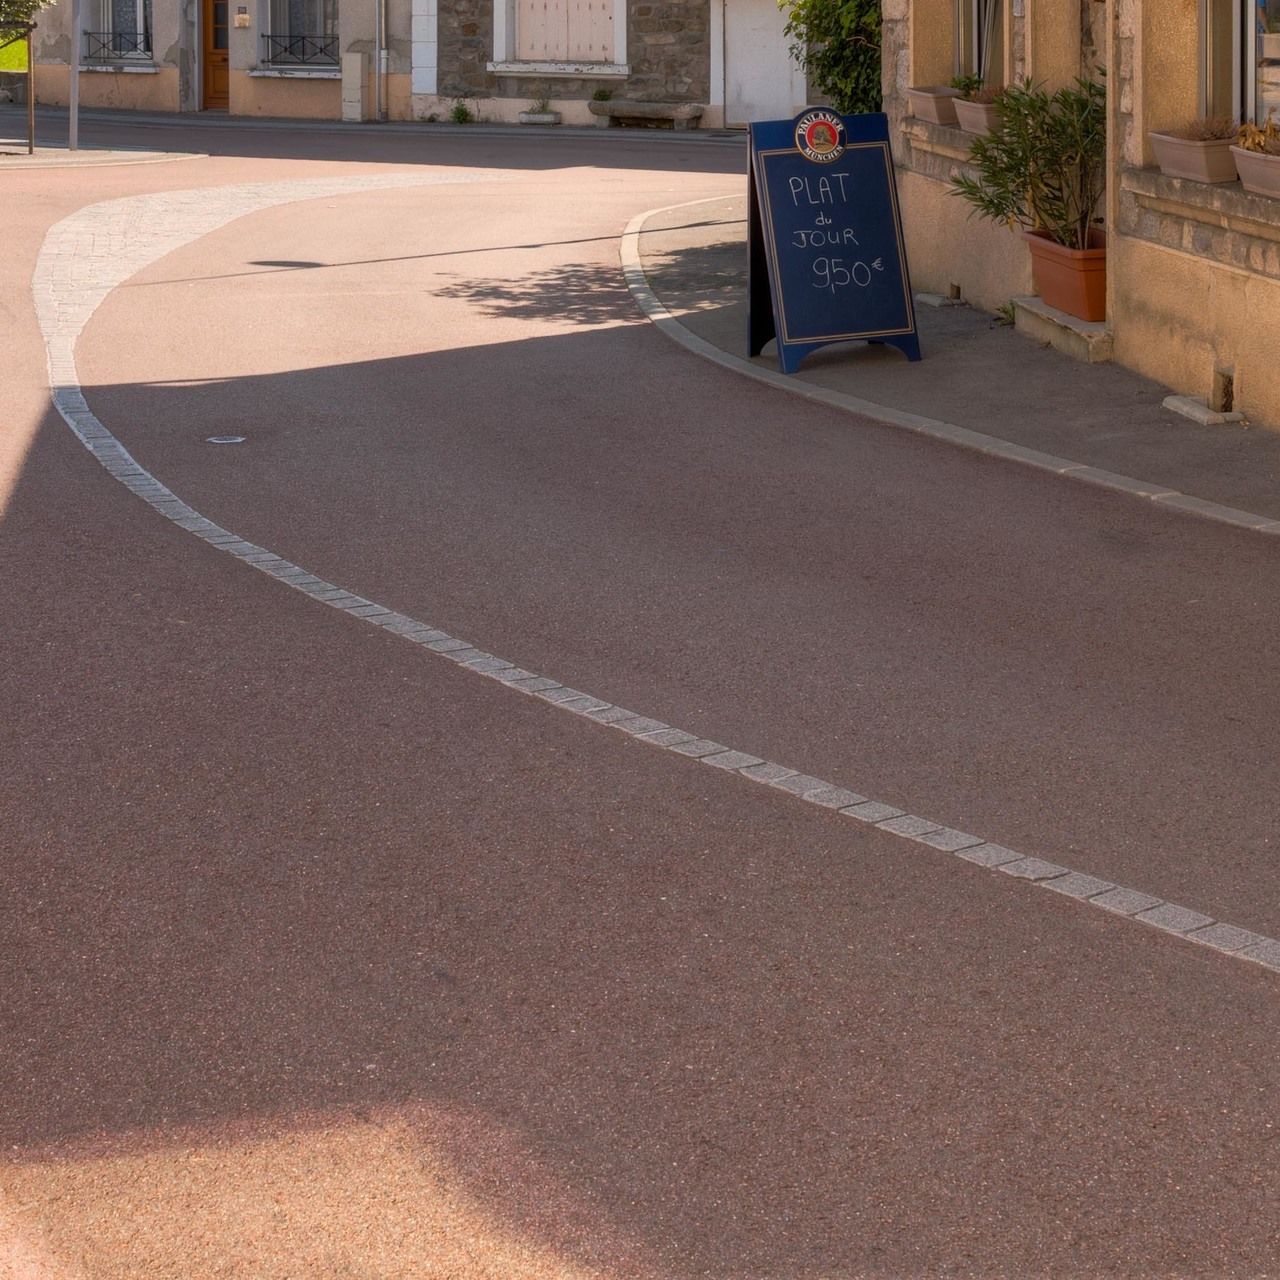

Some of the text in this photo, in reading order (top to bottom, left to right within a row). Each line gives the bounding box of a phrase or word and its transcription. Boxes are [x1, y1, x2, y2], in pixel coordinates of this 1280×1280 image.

[798, 113, 845, 135] PAULANER
[789, 173, 850, 207] PLAT
[815, 211, 832, 225] du
[792, 228, 860, 248] JOUR
